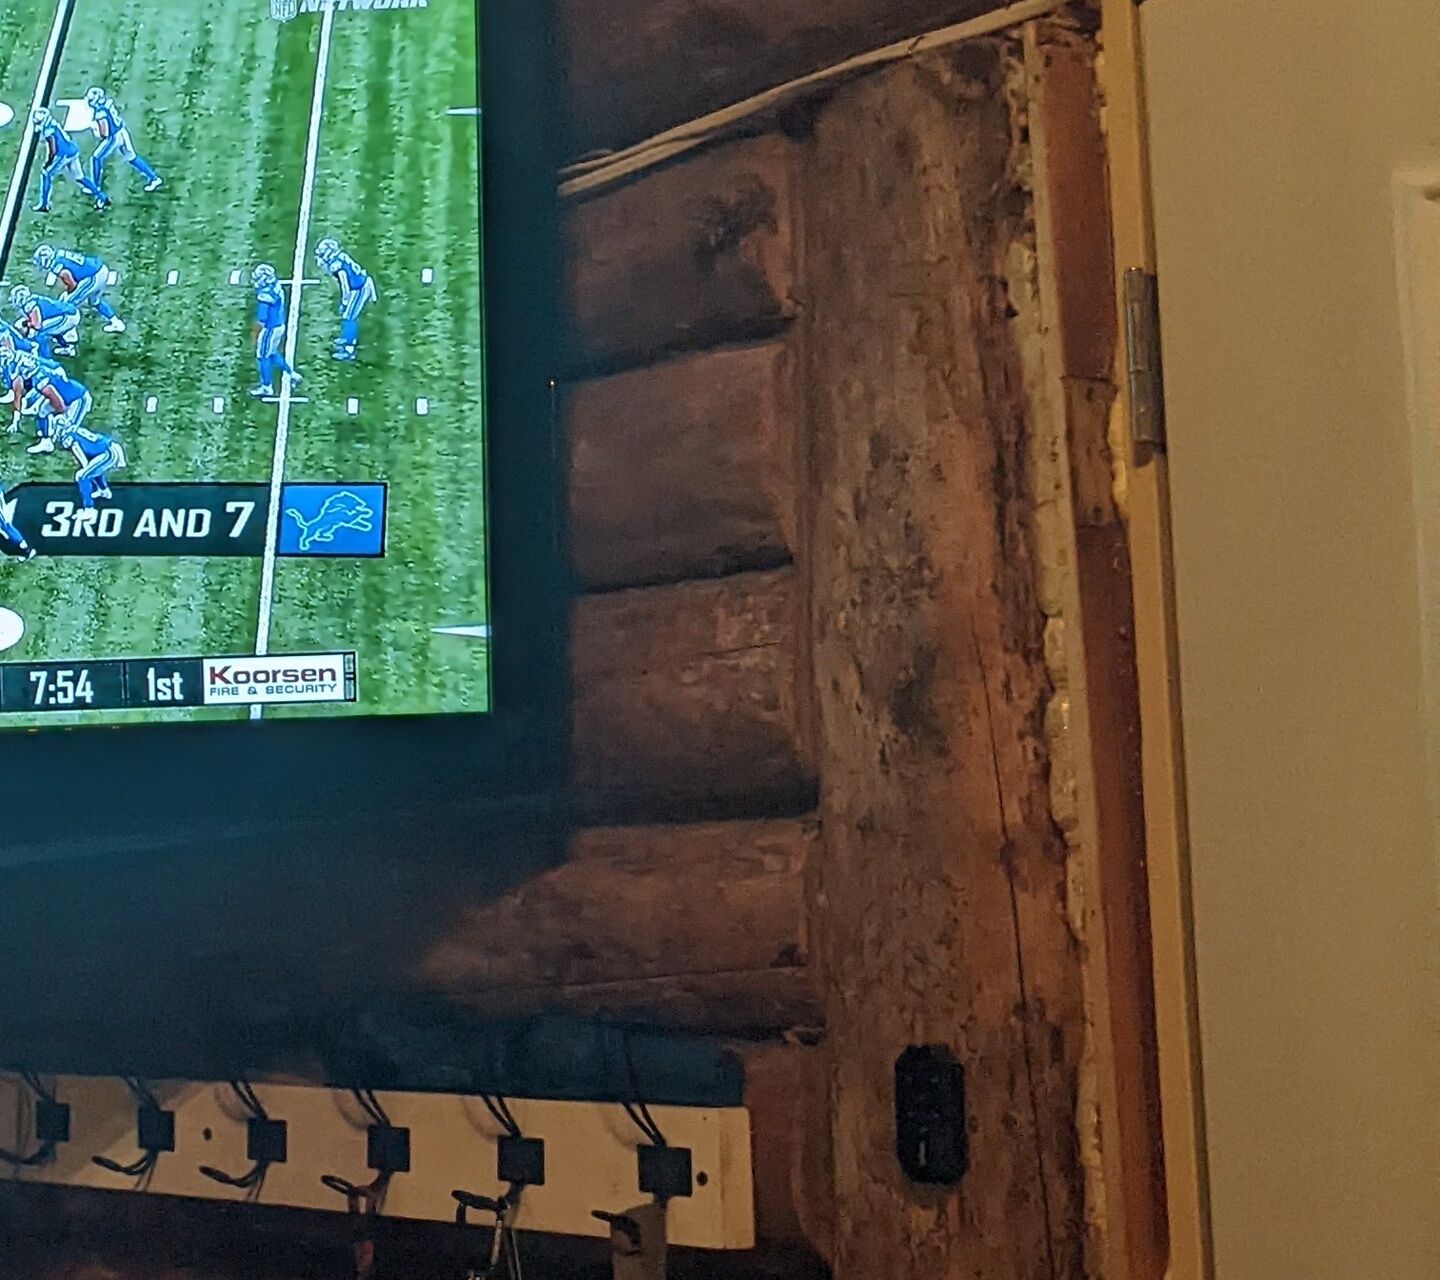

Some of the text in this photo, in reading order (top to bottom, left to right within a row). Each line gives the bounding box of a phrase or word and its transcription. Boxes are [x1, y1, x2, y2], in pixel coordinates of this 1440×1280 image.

[41, 501, 255, 538] 3RD AND 7
[29, 669, 95, 705] 7:54
[146, 666, 184, 702] 1st
[209, 664, 337, 685] Koorsen
[209, 683, 338, 697] FIRE & SECURITY
